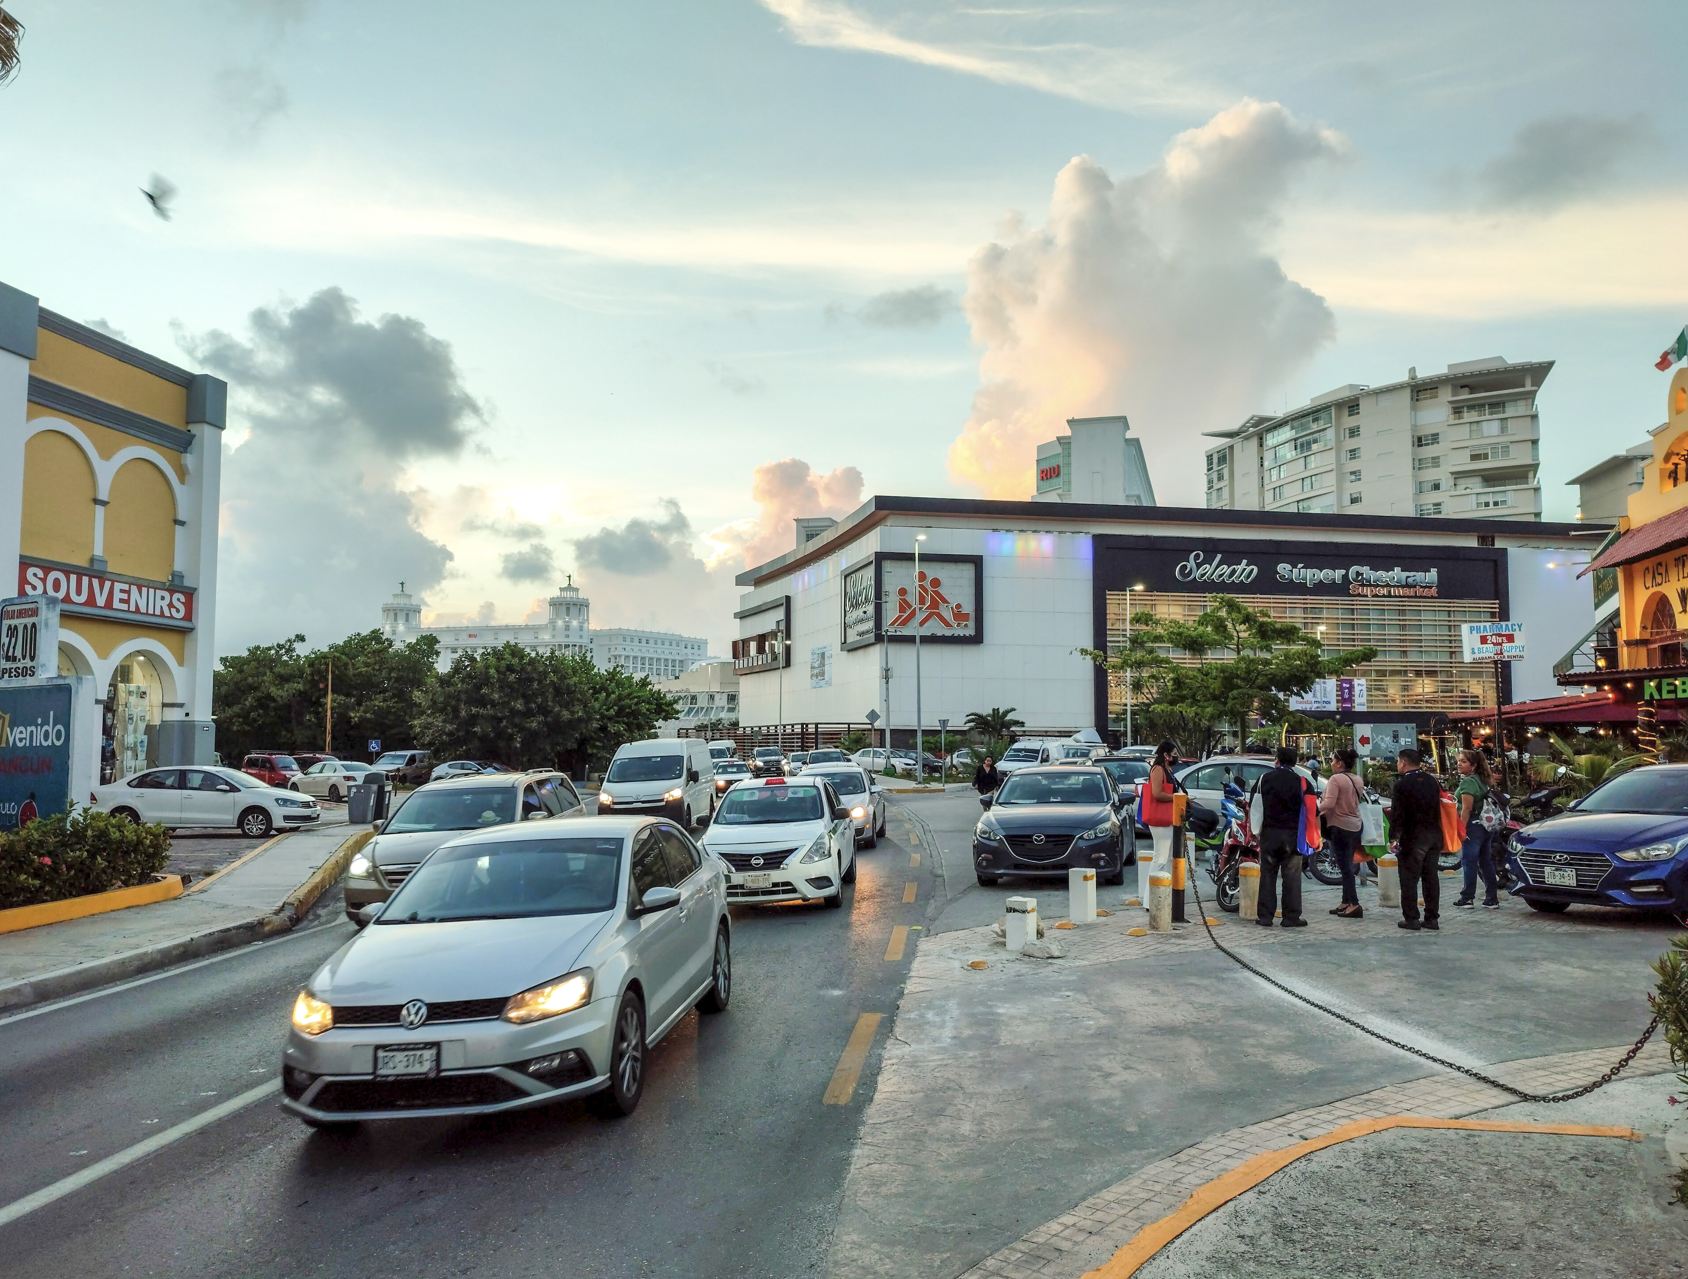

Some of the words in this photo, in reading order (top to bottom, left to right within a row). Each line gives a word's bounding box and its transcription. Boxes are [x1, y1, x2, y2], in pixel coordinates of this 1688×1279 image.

[1039, 464, 1061, 480] RIU
[1175, 550, 1259, 584] Selecto
[1276, 563, 1347, 587] Súper
[1348, 564, 1438, 586] Chedraui
[1643, 560, 1670, 590] CASA
[24, 566, 185, 619] SOUVENIRS
[1349, 583, 1438, 598] Supermarket
[1469, 622, 1523, 634] PHARMACY
[1503, 644, 1525, 653] SUPPLY
[1, 665, 36, 679] PESOS
[7, 710, 66, 748] venido
